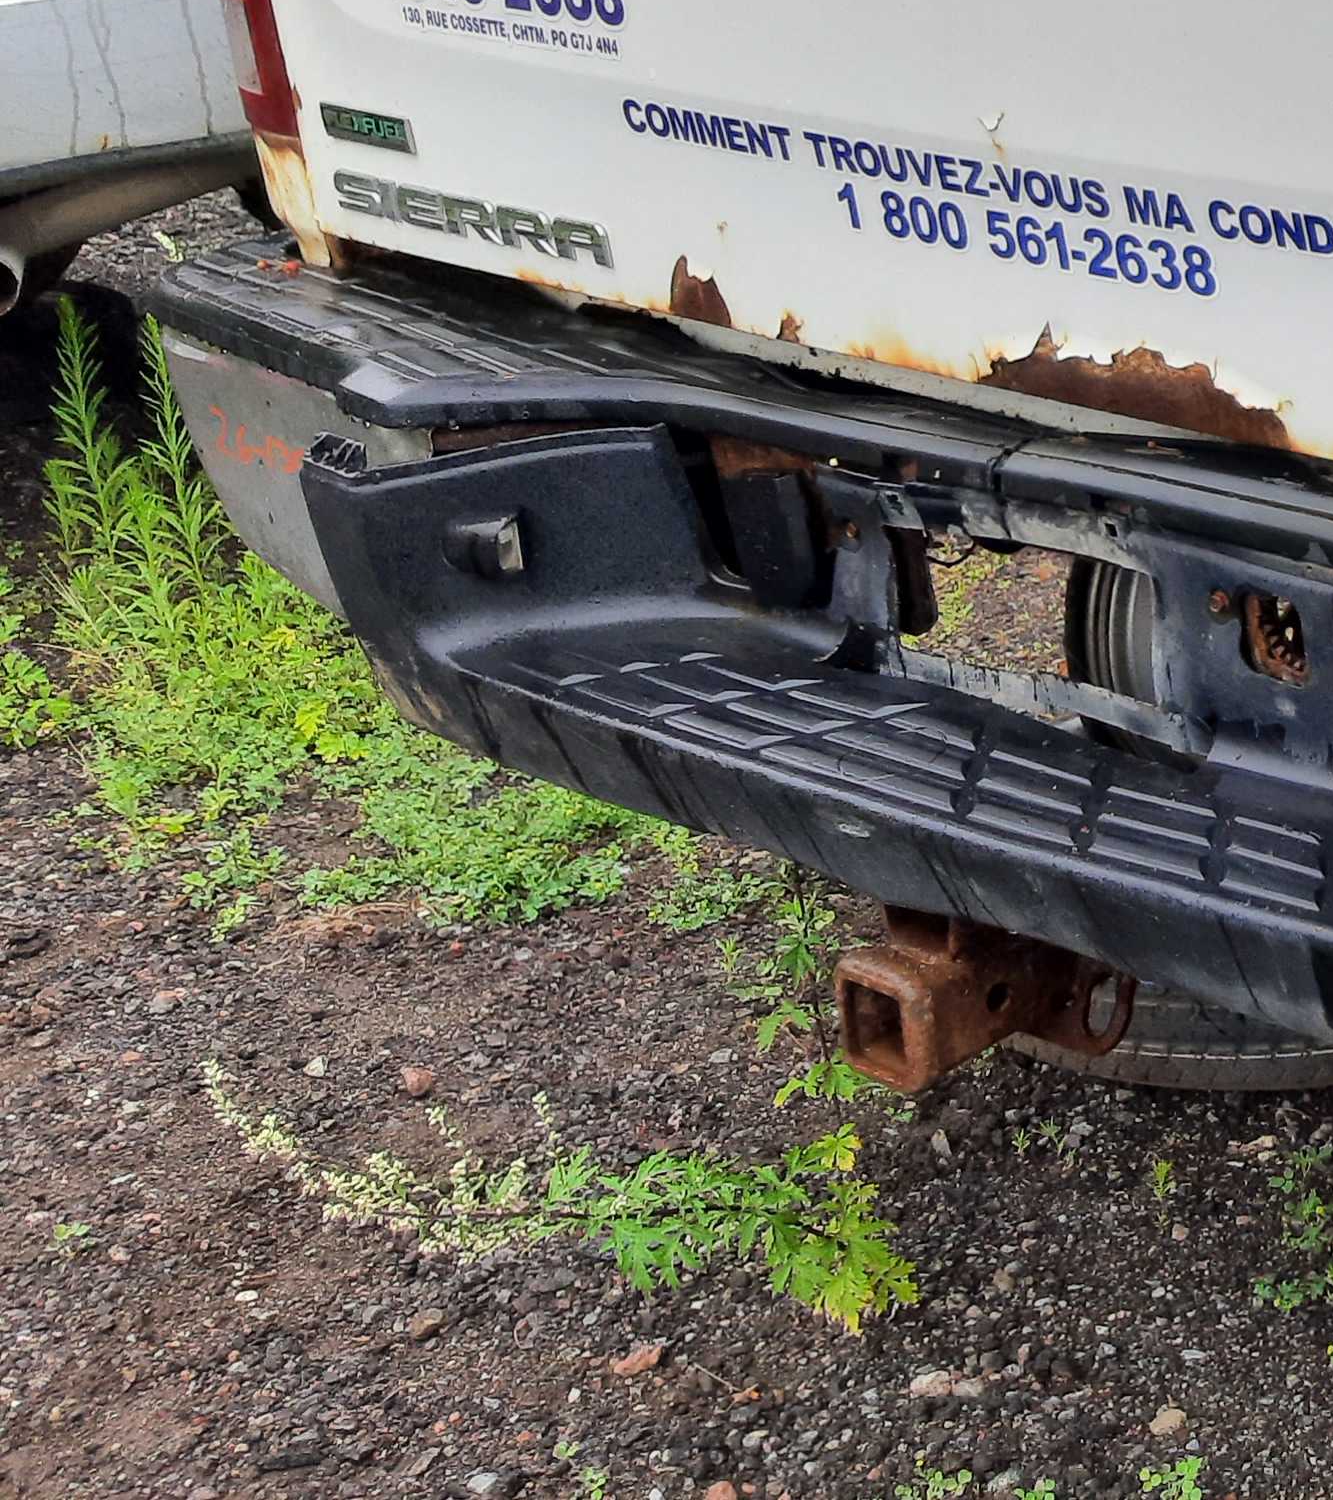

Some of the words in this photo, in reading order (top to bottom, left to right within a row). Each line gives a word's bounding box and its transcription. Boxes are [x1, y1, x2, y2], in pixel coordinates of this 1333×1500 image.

[427, 10, 449, 30] RUE
[450, 14, 511, 40] COSSETTE,
[552, 31, 567, 47] PQ
[571, 34, 593, 52] G7J
[596, 38, 619, 56] 4N4
[333, 168, 615, 269] SIERRA
[623, 100, 791, 161] COMMENT
[803, 132, 1110, 219] TROUVEZ-VOUS
[1123, 185, 1194, 233] MA
[837, 184, 863, 231] 1
[882, 193, 968, 251] 800
[988, 212, 1217, 298] 561-2638
